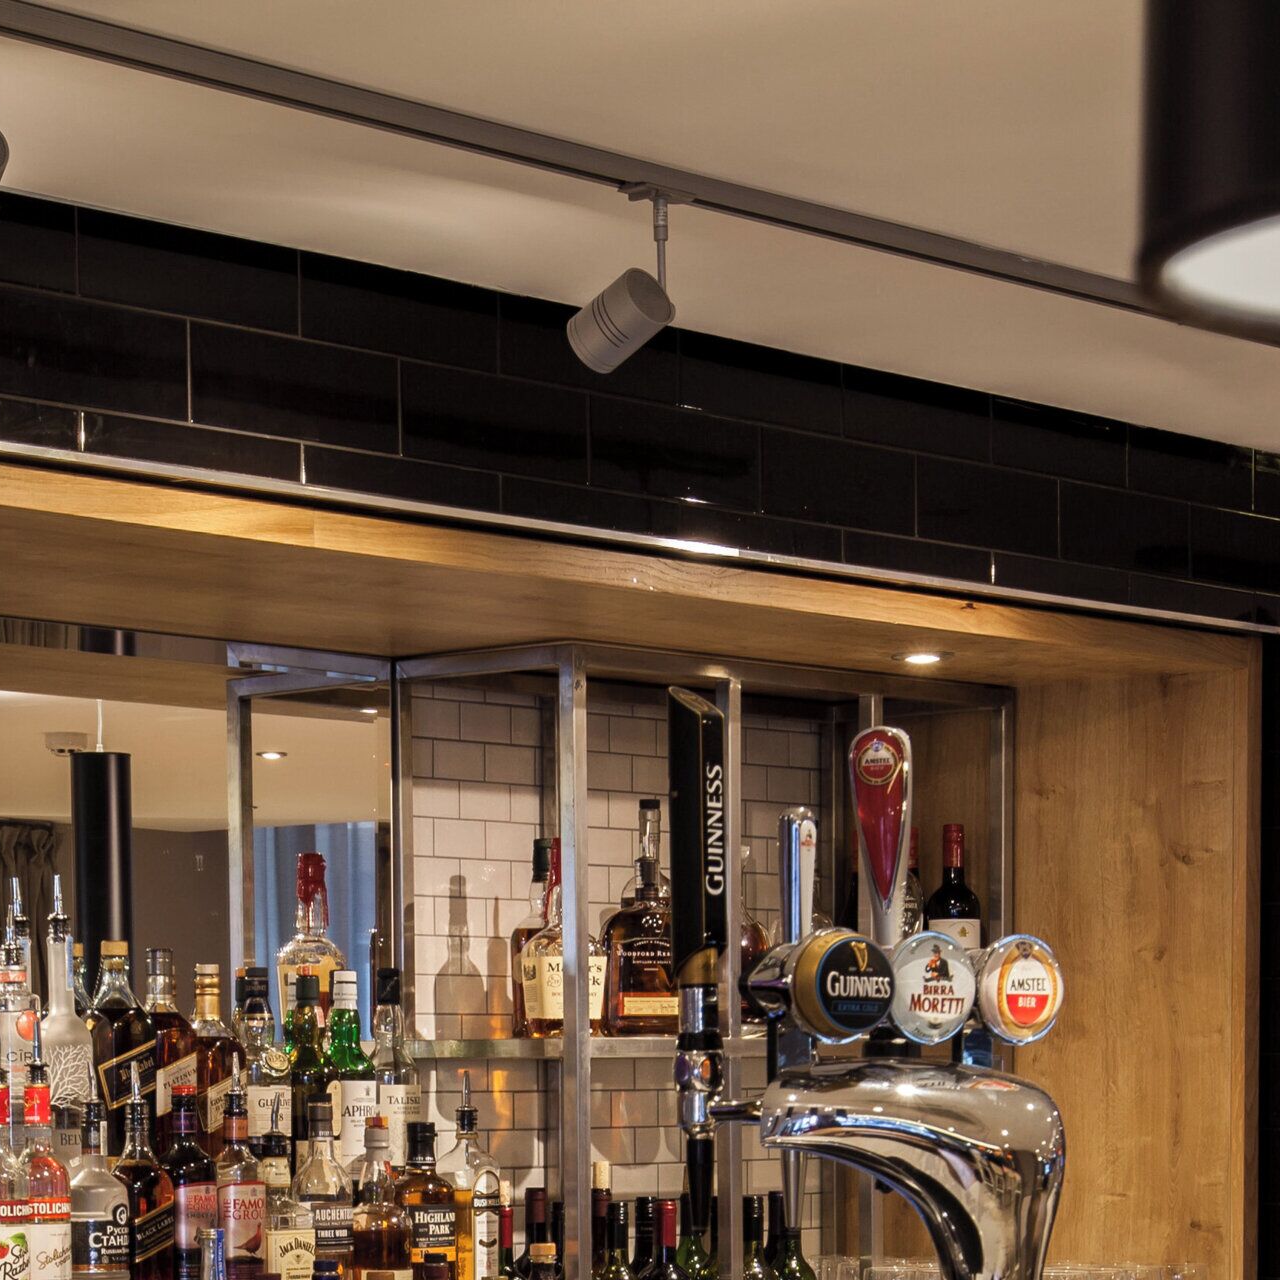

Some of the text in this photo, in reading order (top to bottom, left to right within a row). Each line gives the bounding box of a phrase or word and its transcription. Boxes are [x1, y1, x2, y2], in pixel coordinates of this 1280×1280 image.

[864, 757, 890, 765] AMSTEL
[705, 764, 723, 897] GUINNESS
[827, 971, 891, 998] GUINNESS
[923, 984, 954, 996] BIRRA
[1010, 977, 1046, 992] AMSTEL
[908, 993, 965, 1015] MORETTI
[1018, 996, 1037, 1008] BIER
[223, 1199, 232, 1220] THE
[136, 1227, 156, 1241] BLACK
[317, 1230, 333, 1238] THREE
[429, 1223, 450, 1235] PARK
[279, 1241, 294, 1258] JACK
